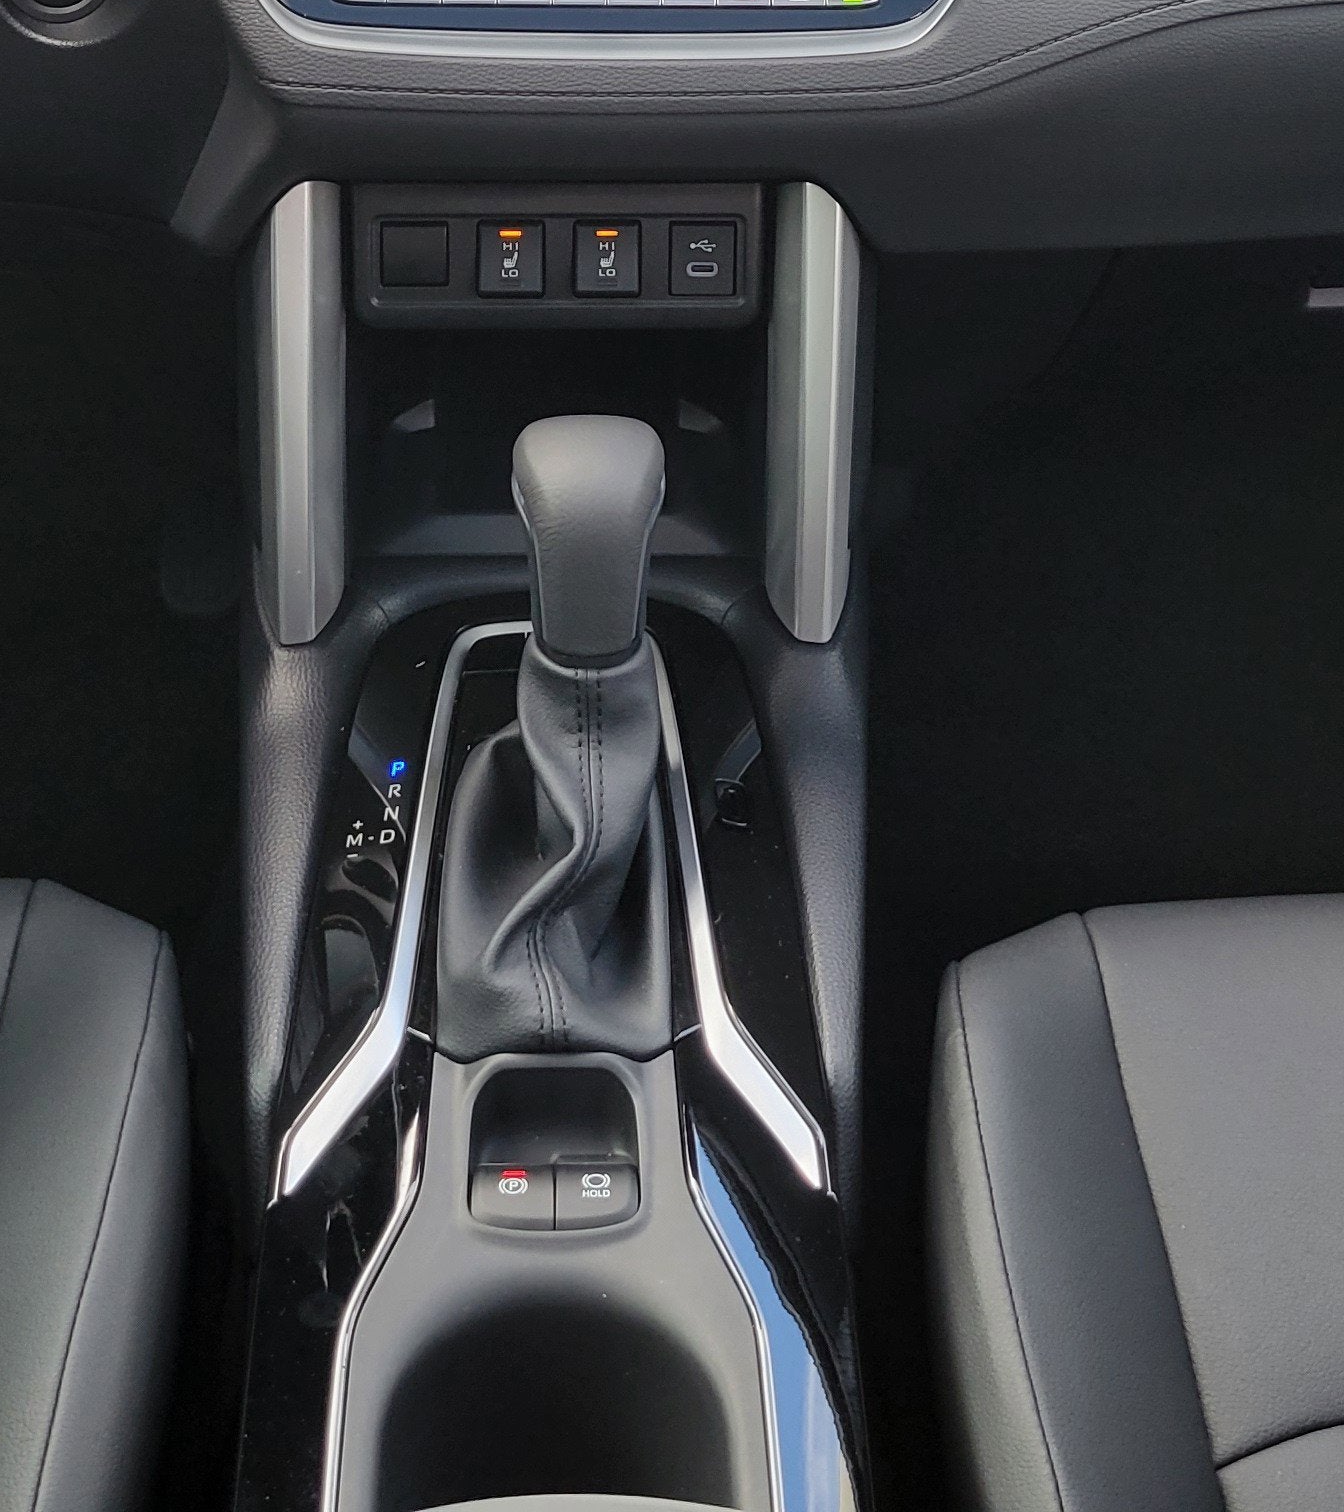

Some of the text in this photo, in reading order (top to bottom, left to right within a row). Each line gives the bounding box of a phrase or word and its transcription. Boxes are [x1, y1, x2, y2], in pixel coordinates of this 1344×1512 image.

[502, 241, 519, 251] HI
[599, 241, 615, 251] HI
[501, 268, 519, 278] LO
[598, 268, 616, 277] LO
[390, 761, 405, 777] P
[387, 783, 402, 799] R
[383, 805, 400, 821] N
[345, 829, 396, 848] M D
[581, 1189, 611, 1198] HOLD
